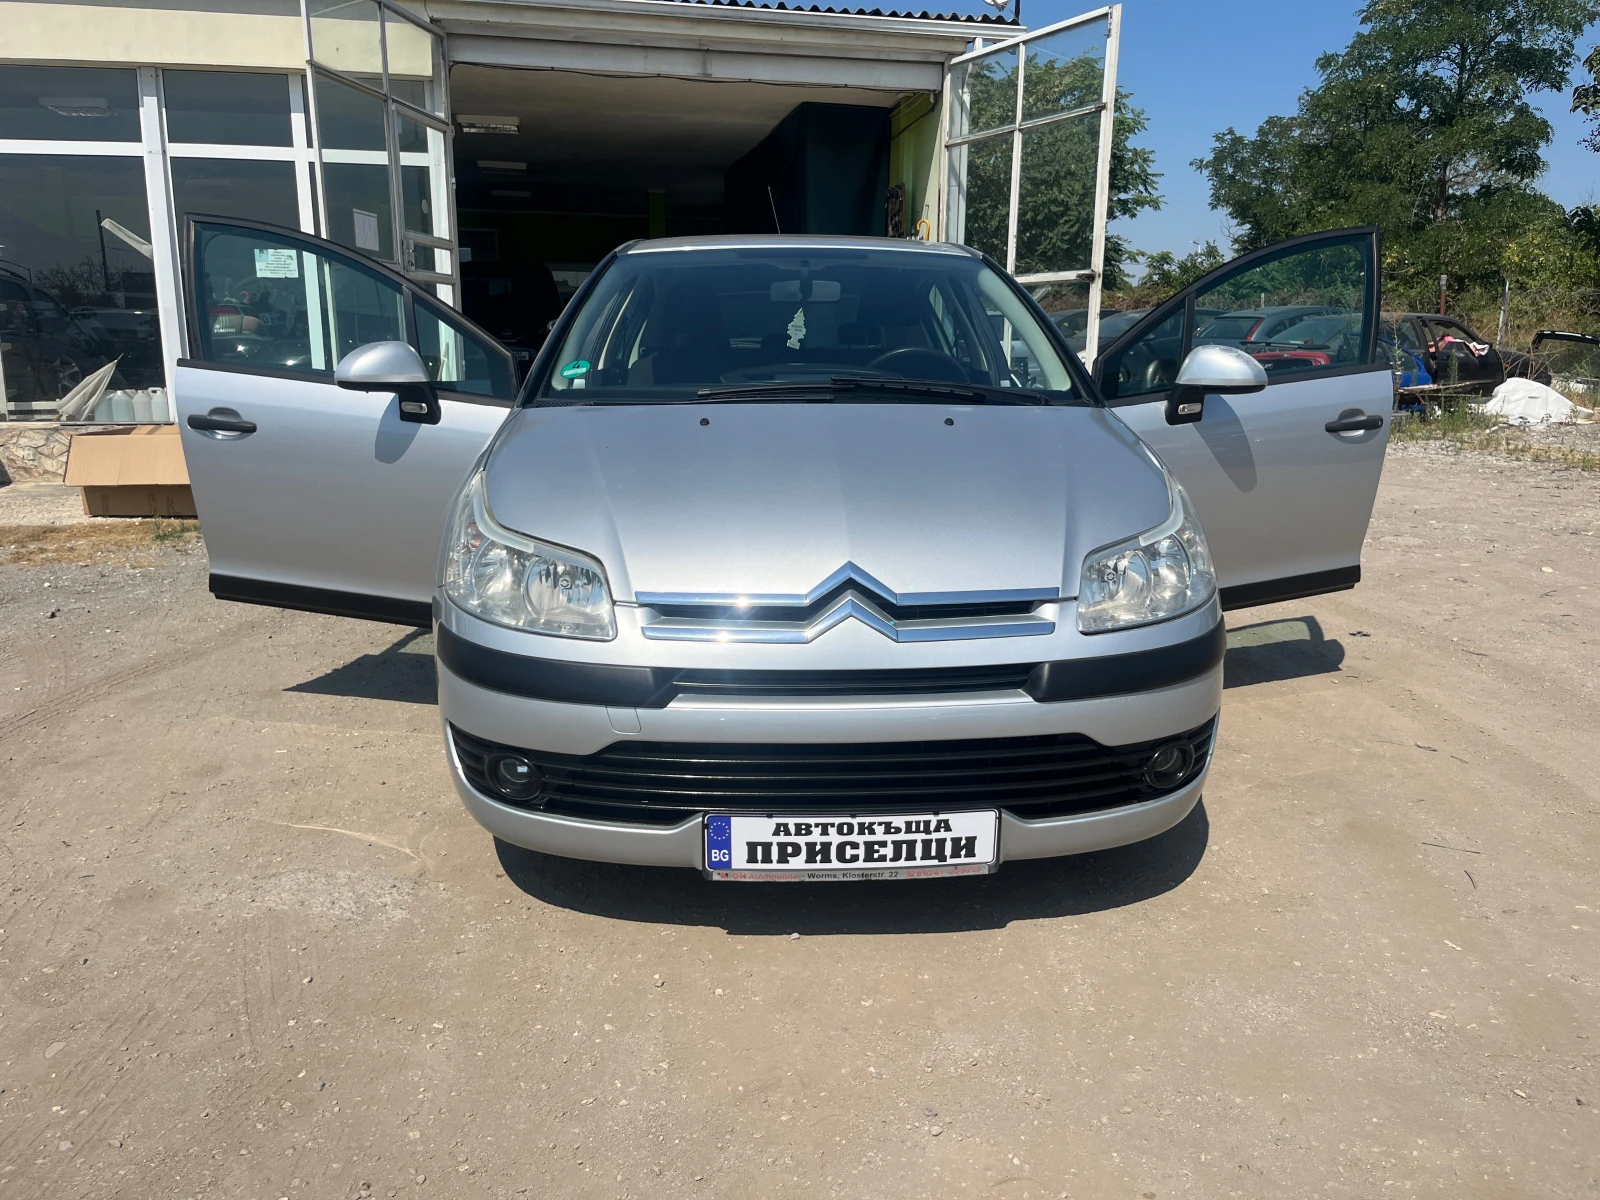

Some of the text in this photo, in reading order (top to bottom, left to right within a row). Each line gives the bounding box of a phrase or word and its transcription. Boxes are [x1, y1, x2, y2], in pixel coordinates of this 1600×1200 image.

[572, 361, 581, 369] 4
[772, 818, 953, 837] АВТОКЪЩА
[711, 849, 729, 862] BG
[745, 836, 978, 864] ПРИСЕЛЦИ
[842, 871, 886, 879] Klosterstr.
